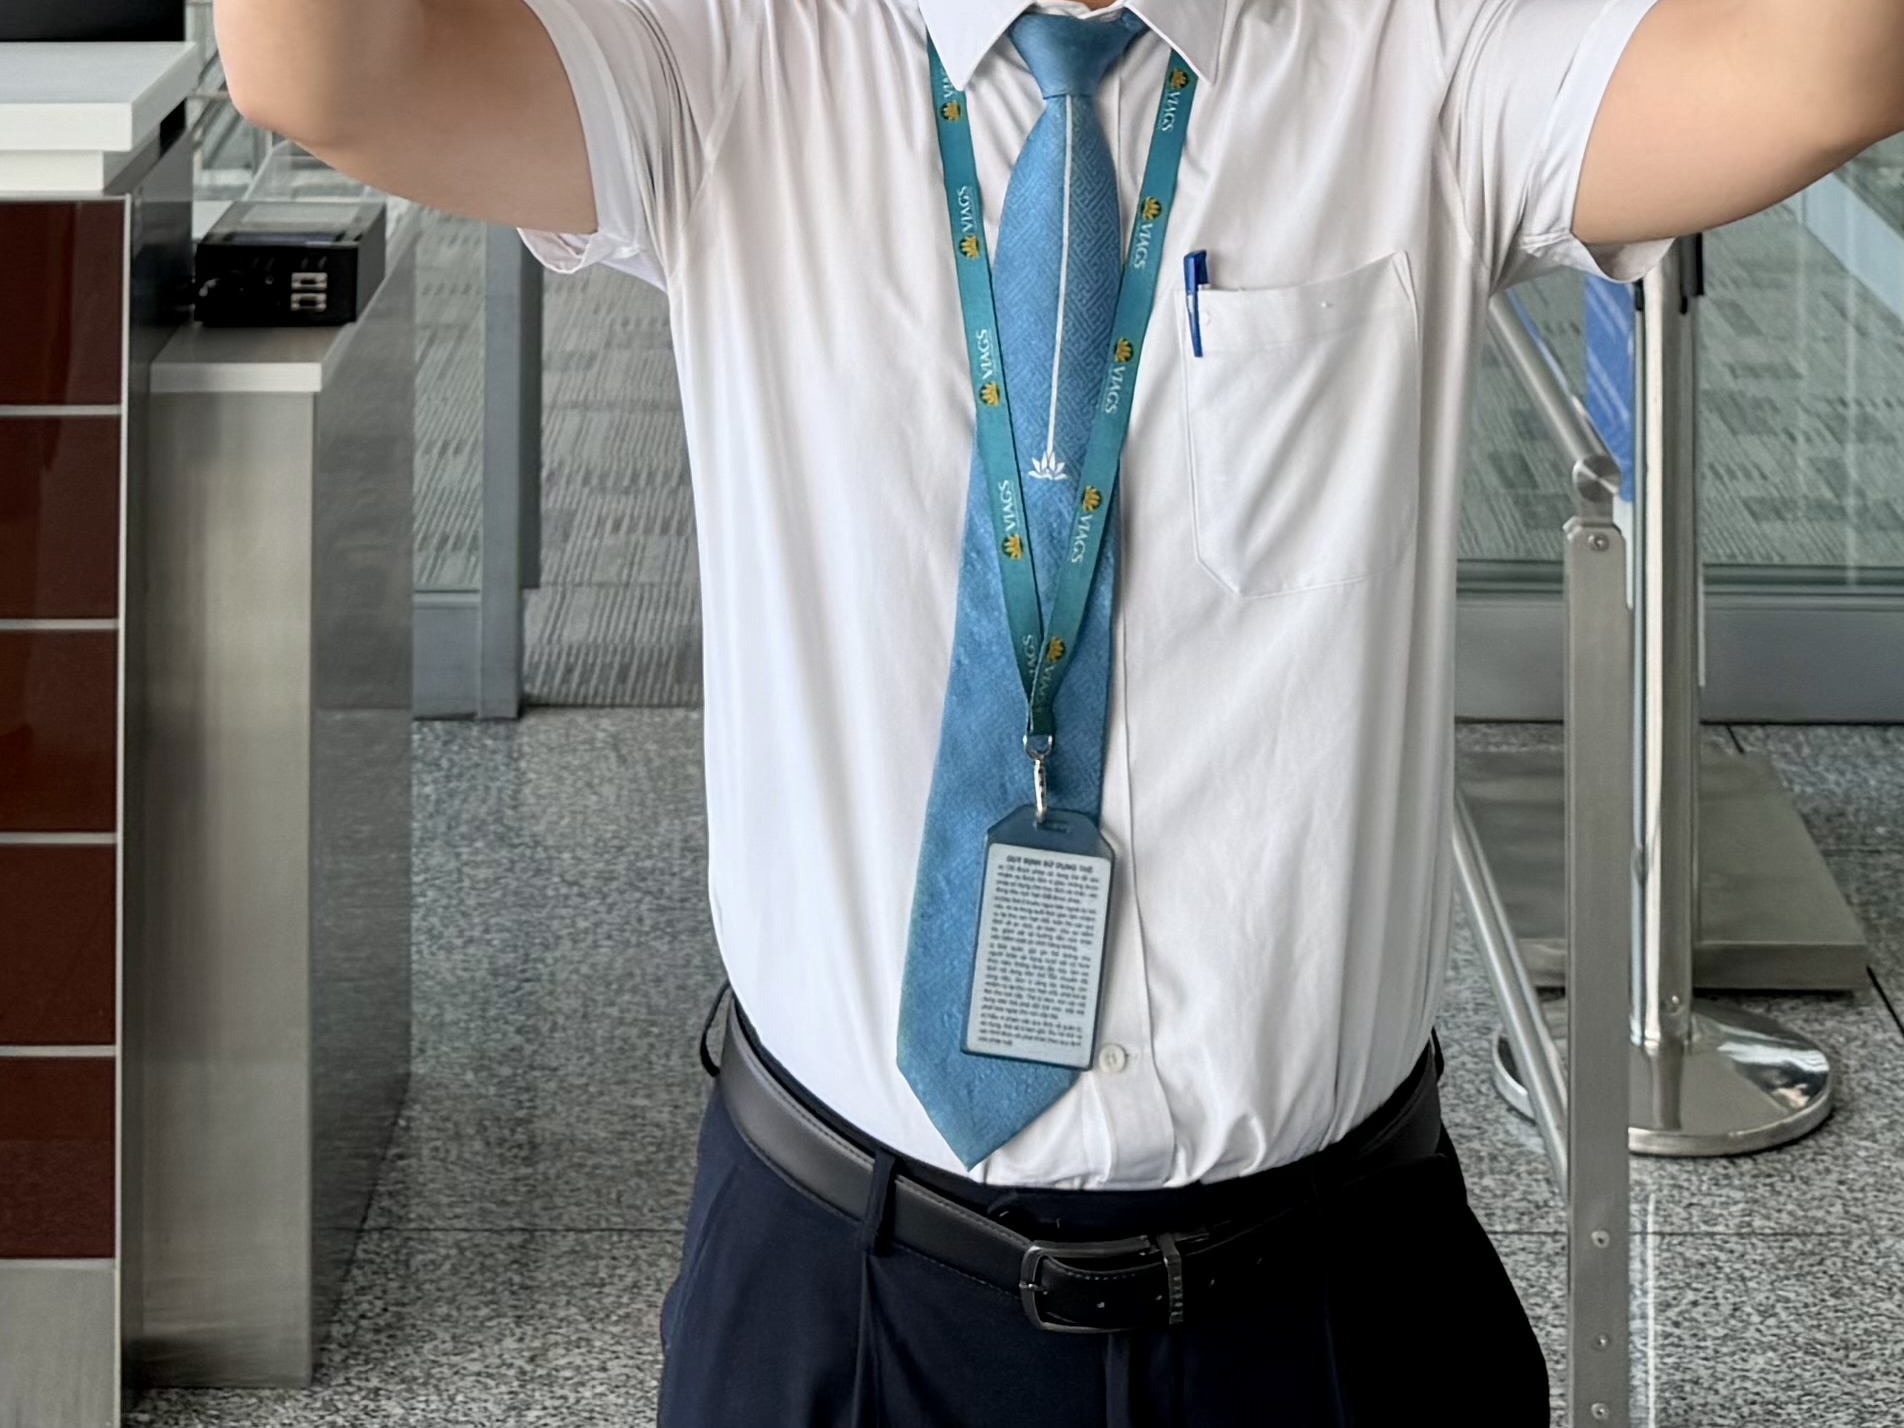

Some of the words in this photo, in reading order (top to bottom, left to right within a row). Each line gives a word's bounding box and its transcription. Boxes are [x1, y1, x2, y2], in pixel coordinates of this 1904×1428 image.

[1161, 91, 1181, 132] VIAGS
[957, 185, 971, 233] VIAGS
[1134, 223, 1153, 269] VIAGS
[976, 329, 993, 380] VIAGS
[1105, 365, 1126, 414] VIAGS
[999, 480, 1017, 532] VIAGS
[1071, 514, 1093, 563] VIAGS
